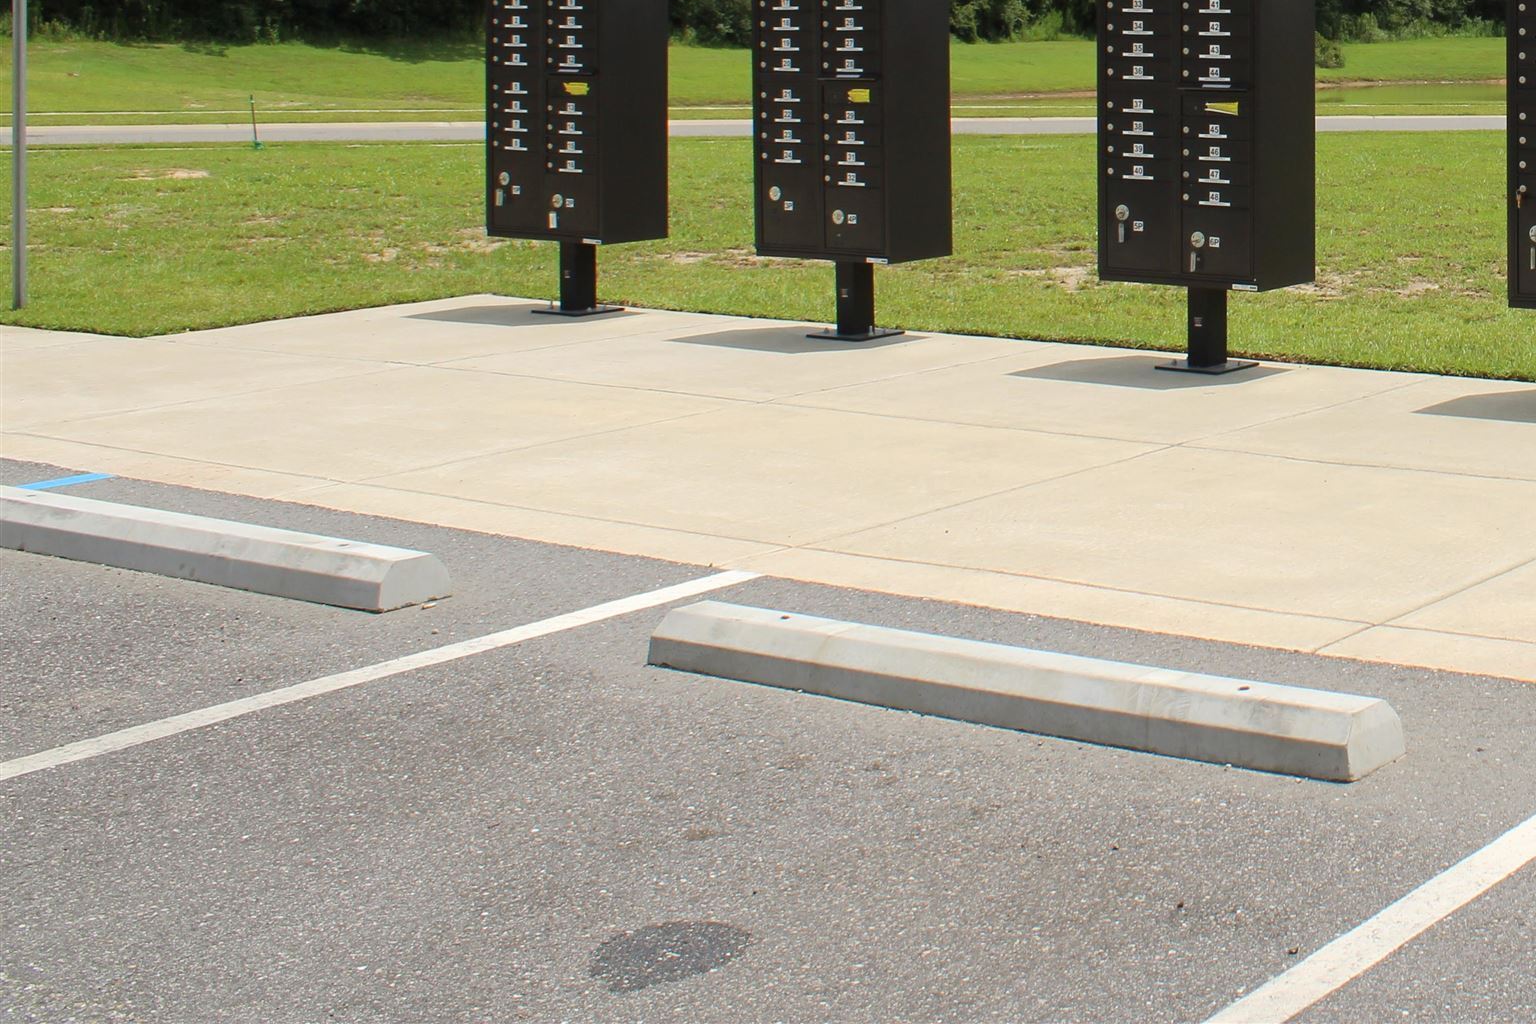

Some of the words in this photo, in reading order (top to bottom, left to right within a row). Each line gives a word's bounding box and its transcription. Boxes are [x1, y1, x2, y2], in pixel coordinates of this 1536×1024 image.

[1134, 0, 1142, 8] 33
[1211, 0, 1219, 9] 41
[1134, 22, 1142, 30] 34
[1211, 23, 1219, 31] 42
[846, 39, 853, 47] 27
[1134, 44, 1142, 52] 35
[1211, 46, 1219, 54] 43
[1134, 67, 1142, 75] 36
[1211, 68, 1219, 76] 44
[1134, 100, 1142, 108] 37
[1134, 122, 1142, 130] 38
[1211, 125, 1219, 133] 45
[1134, 144, 1142, 153] 39
[1211, 147, 1219, 155] 46
[1134, 167, 1142, 175] 40
[1211, 170, 1219, 178] 47
[1211, 192, 1219, 201] 48
[1134, 222, 1142, 230] 5P
[1210, 238, 1218, 246] 6P
